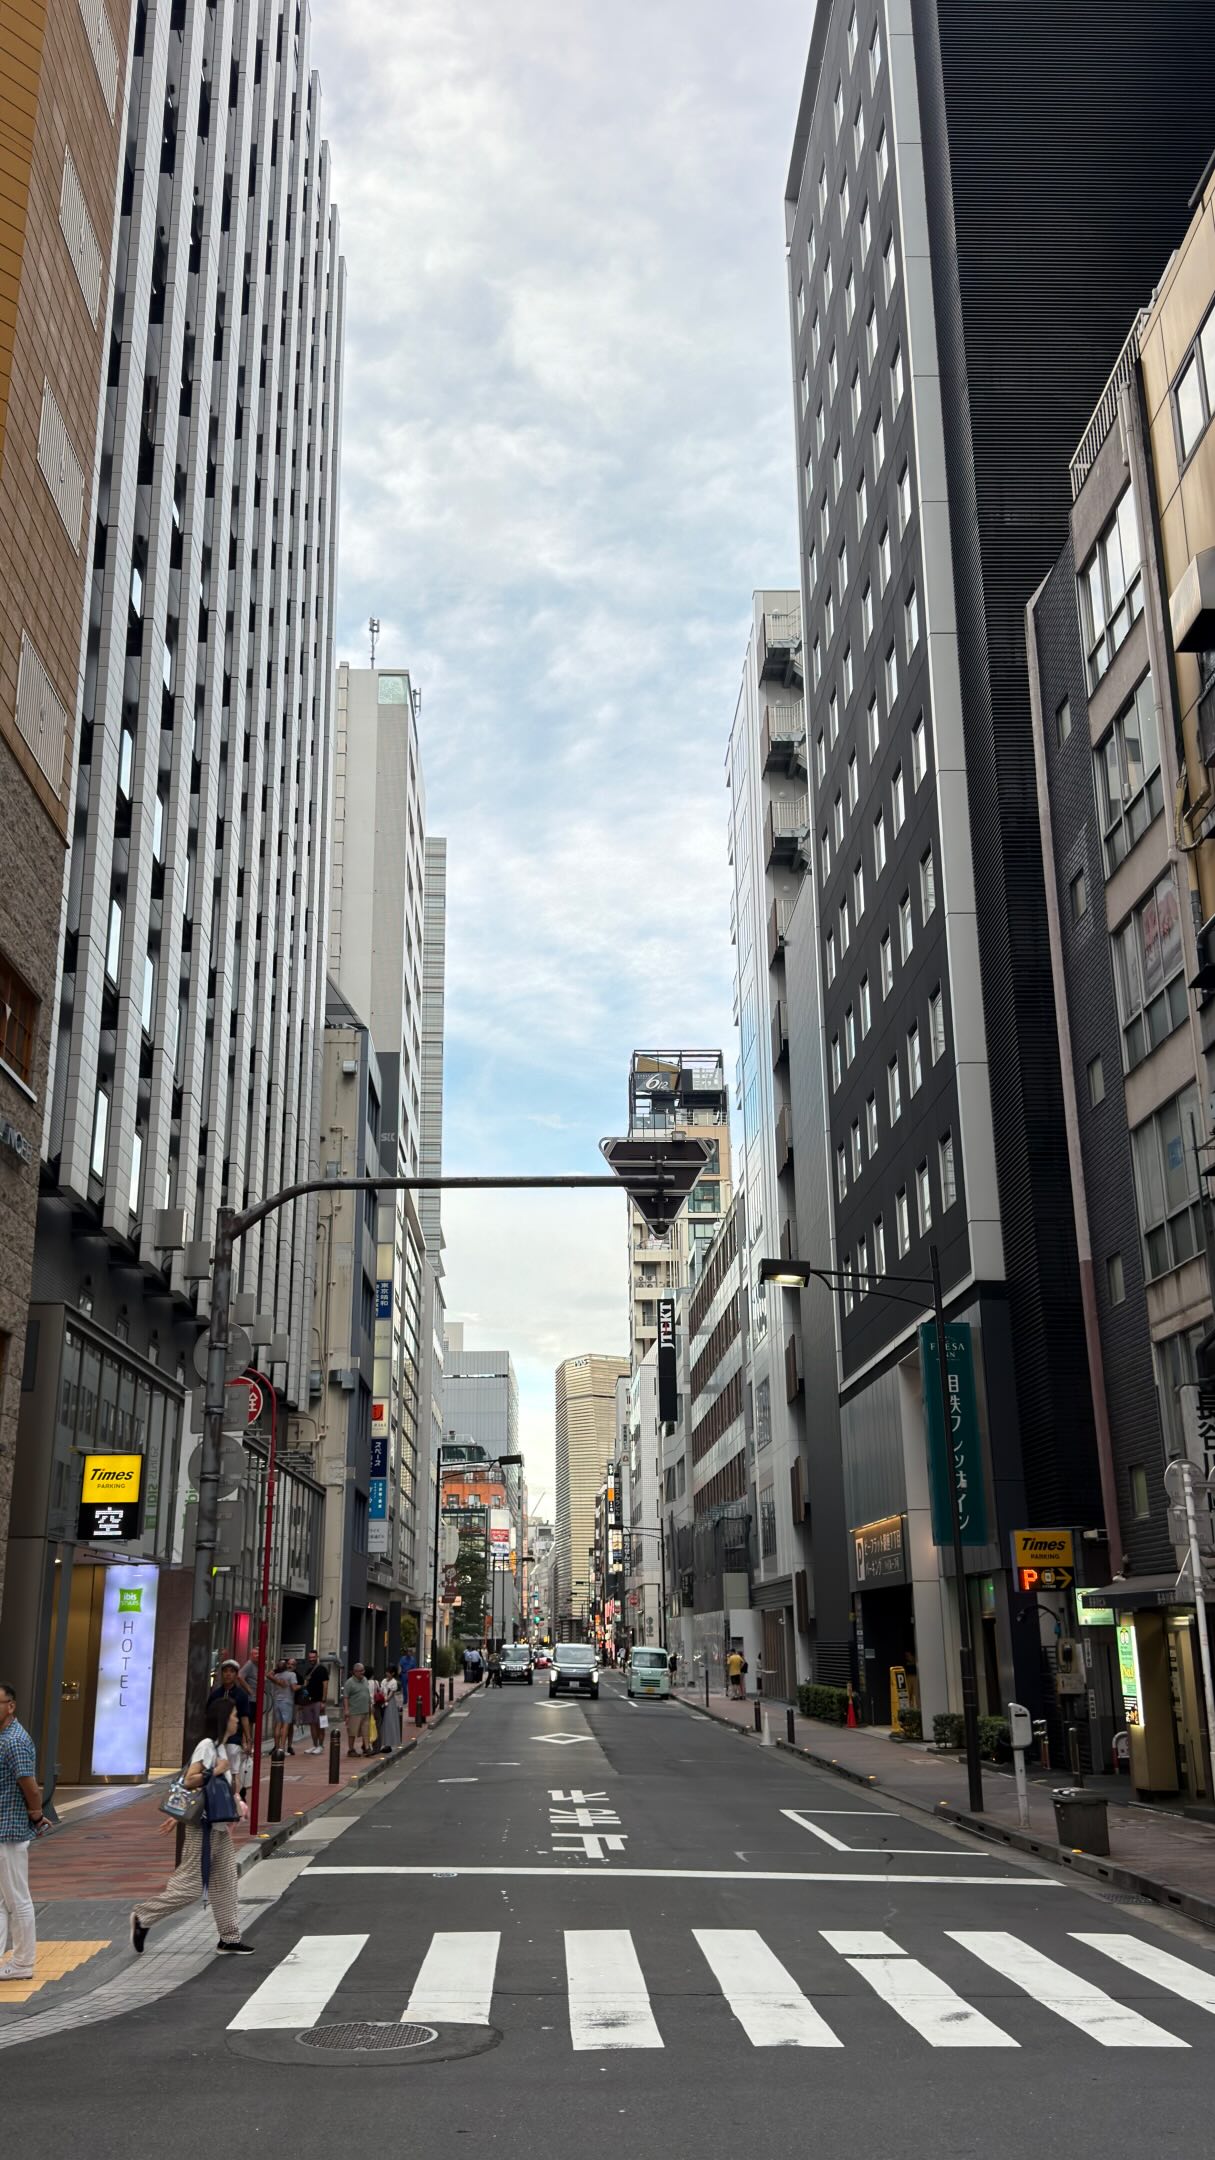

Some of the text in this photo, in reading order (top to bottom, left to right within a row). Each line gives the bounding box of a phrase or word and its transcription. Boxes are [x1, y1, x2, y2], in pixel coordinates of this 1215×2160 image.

[660, 1302, 676, 1349] JTEKT
[930, 1342, 965, 1351] FESA
[90, 1468, 134, 1480] Times
[93, 1506, 124, 1536] 空
[1022, 1537, 1066, 1550] Times
[857, 1540, 864, 1580] P
[1023, 1569, 1038, 1590] P
[123, 1592, 137, 1600] ibis
[119, 1620, 134, 1707] HOTEL
[897, 1674, 905, 1689] P
